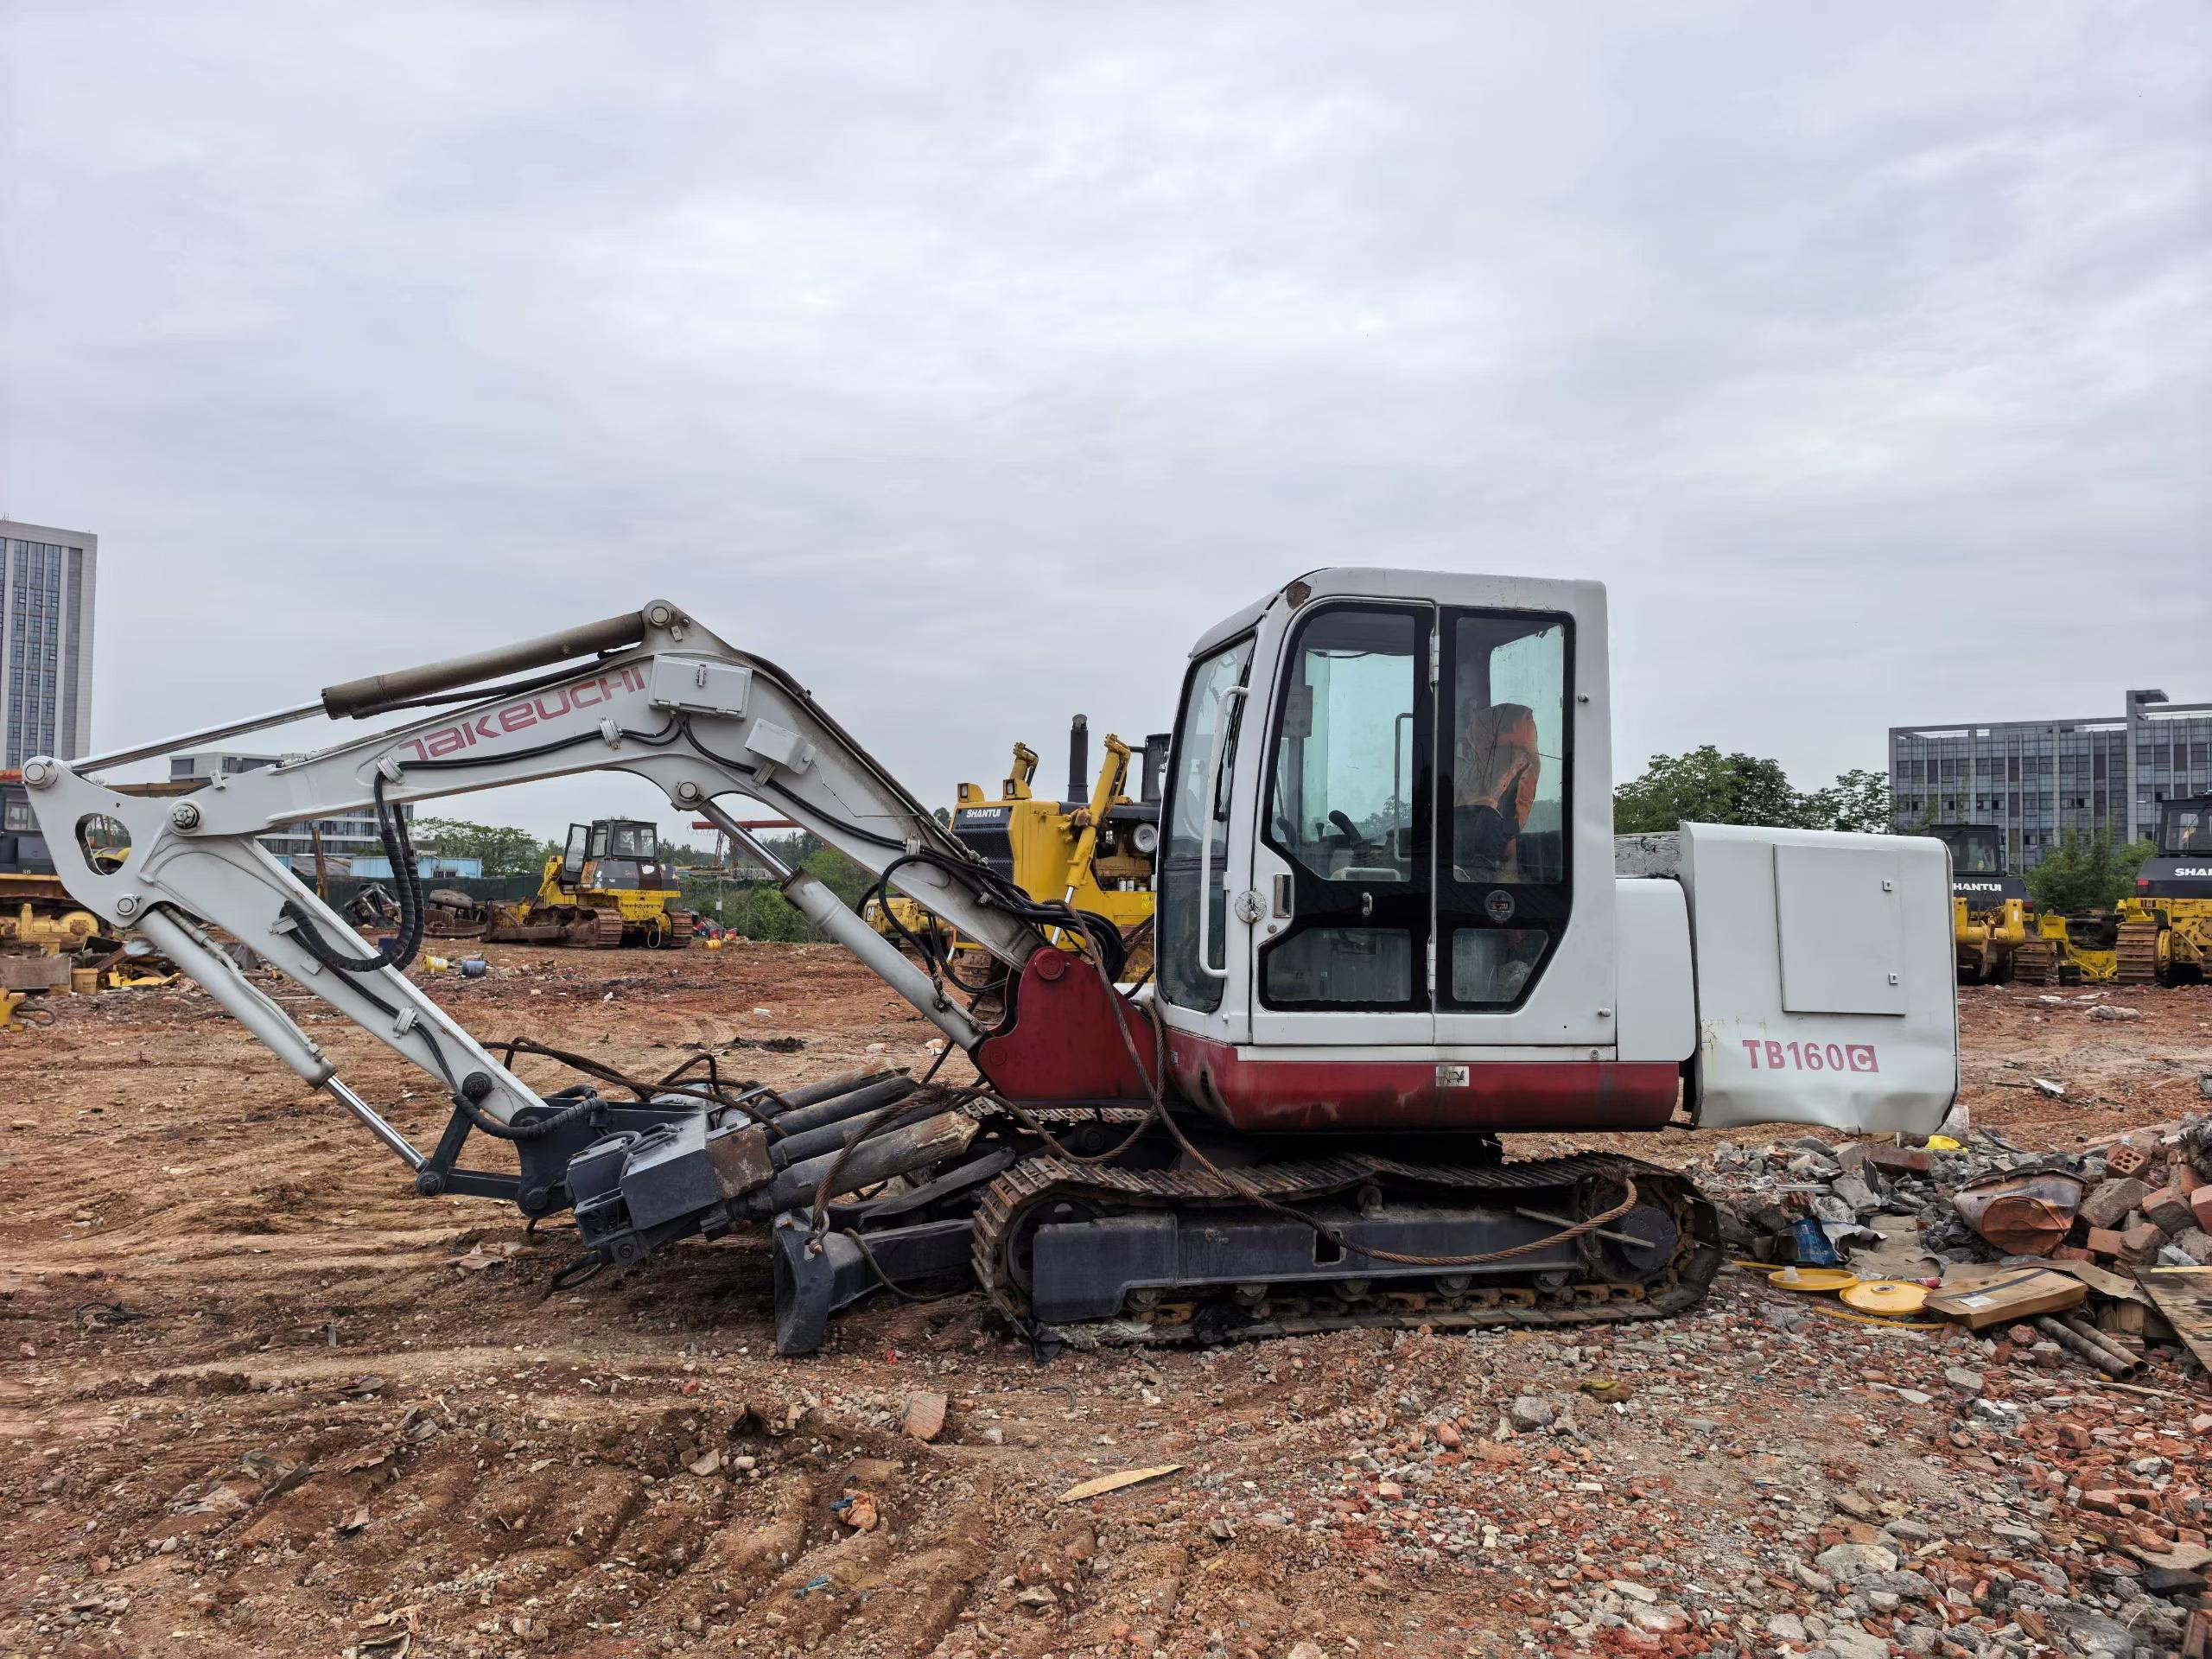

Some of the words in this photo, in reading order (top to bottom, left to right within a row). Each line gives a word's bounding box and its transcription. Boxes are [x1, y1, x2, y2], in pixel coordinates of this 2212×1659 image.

[966, 809, 1001, 818] SHANTUI
[1953, 882, 2002, 892] HANTUI
[1742, 1039, 1879, 1073] TB160C
